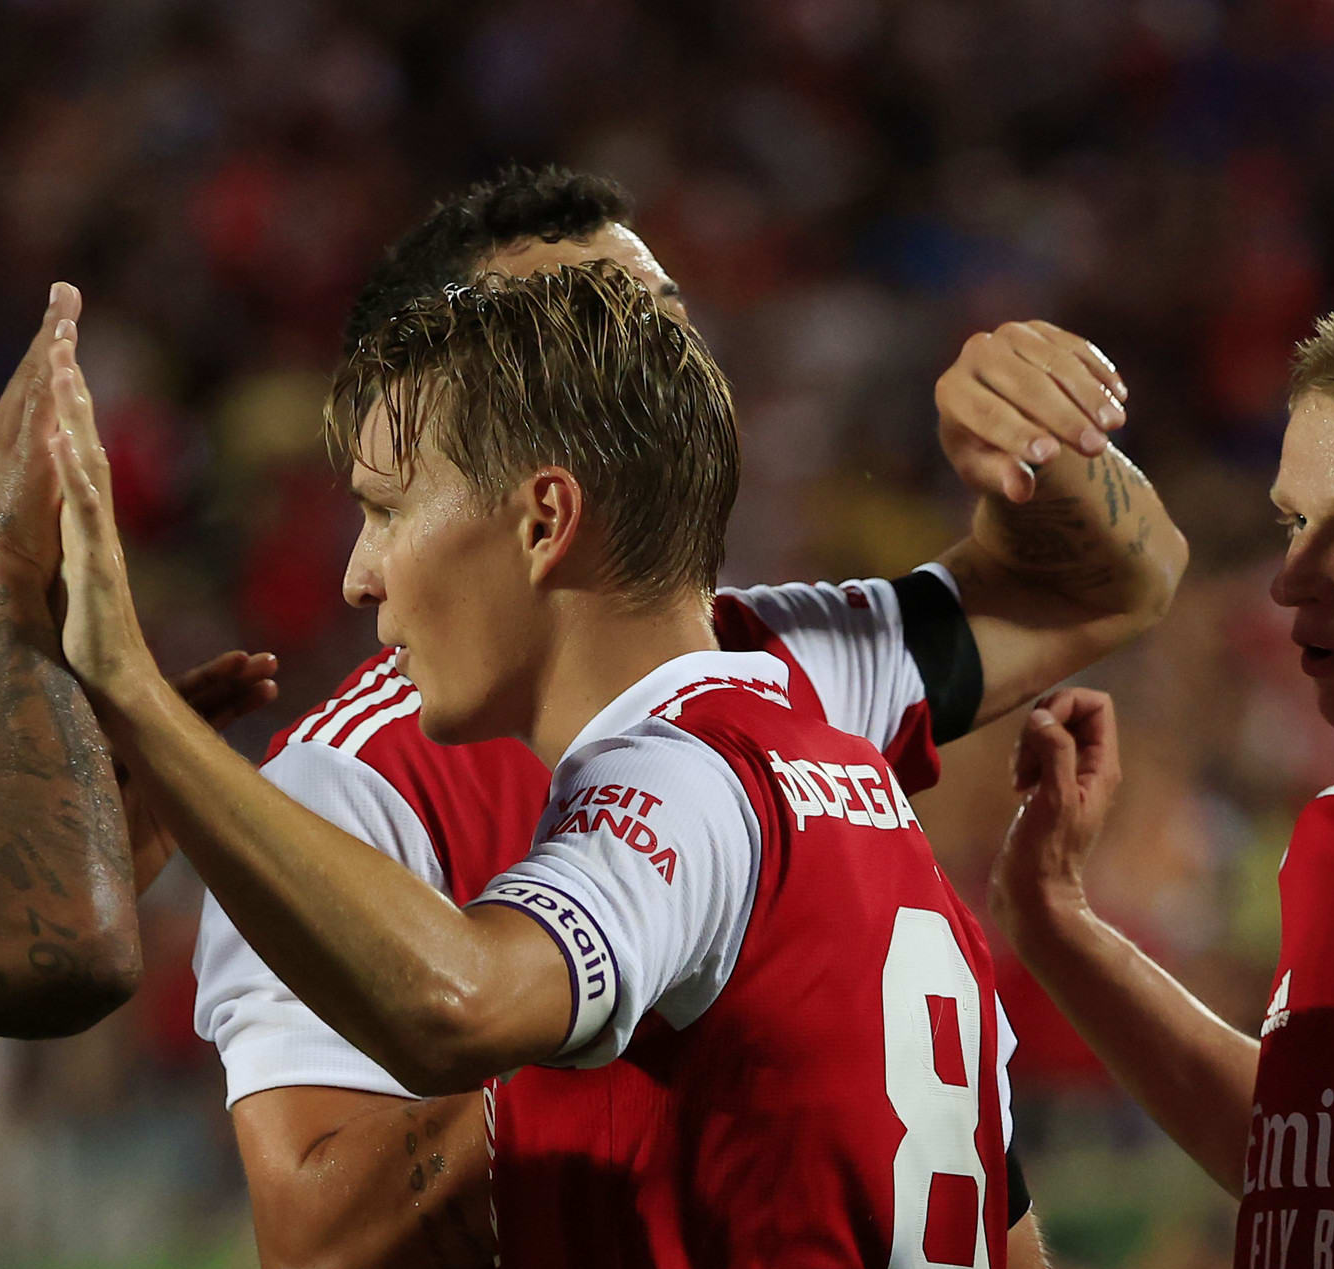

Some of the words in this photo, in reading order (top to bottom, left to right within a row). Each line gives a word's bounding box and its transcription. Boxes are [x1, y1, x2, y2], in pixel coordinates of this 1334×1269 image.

[558, 784, 663, 818] VISIT
[768, 750, 924, 832] ØDEGA
[489, 886, 606, 1000] aptain
